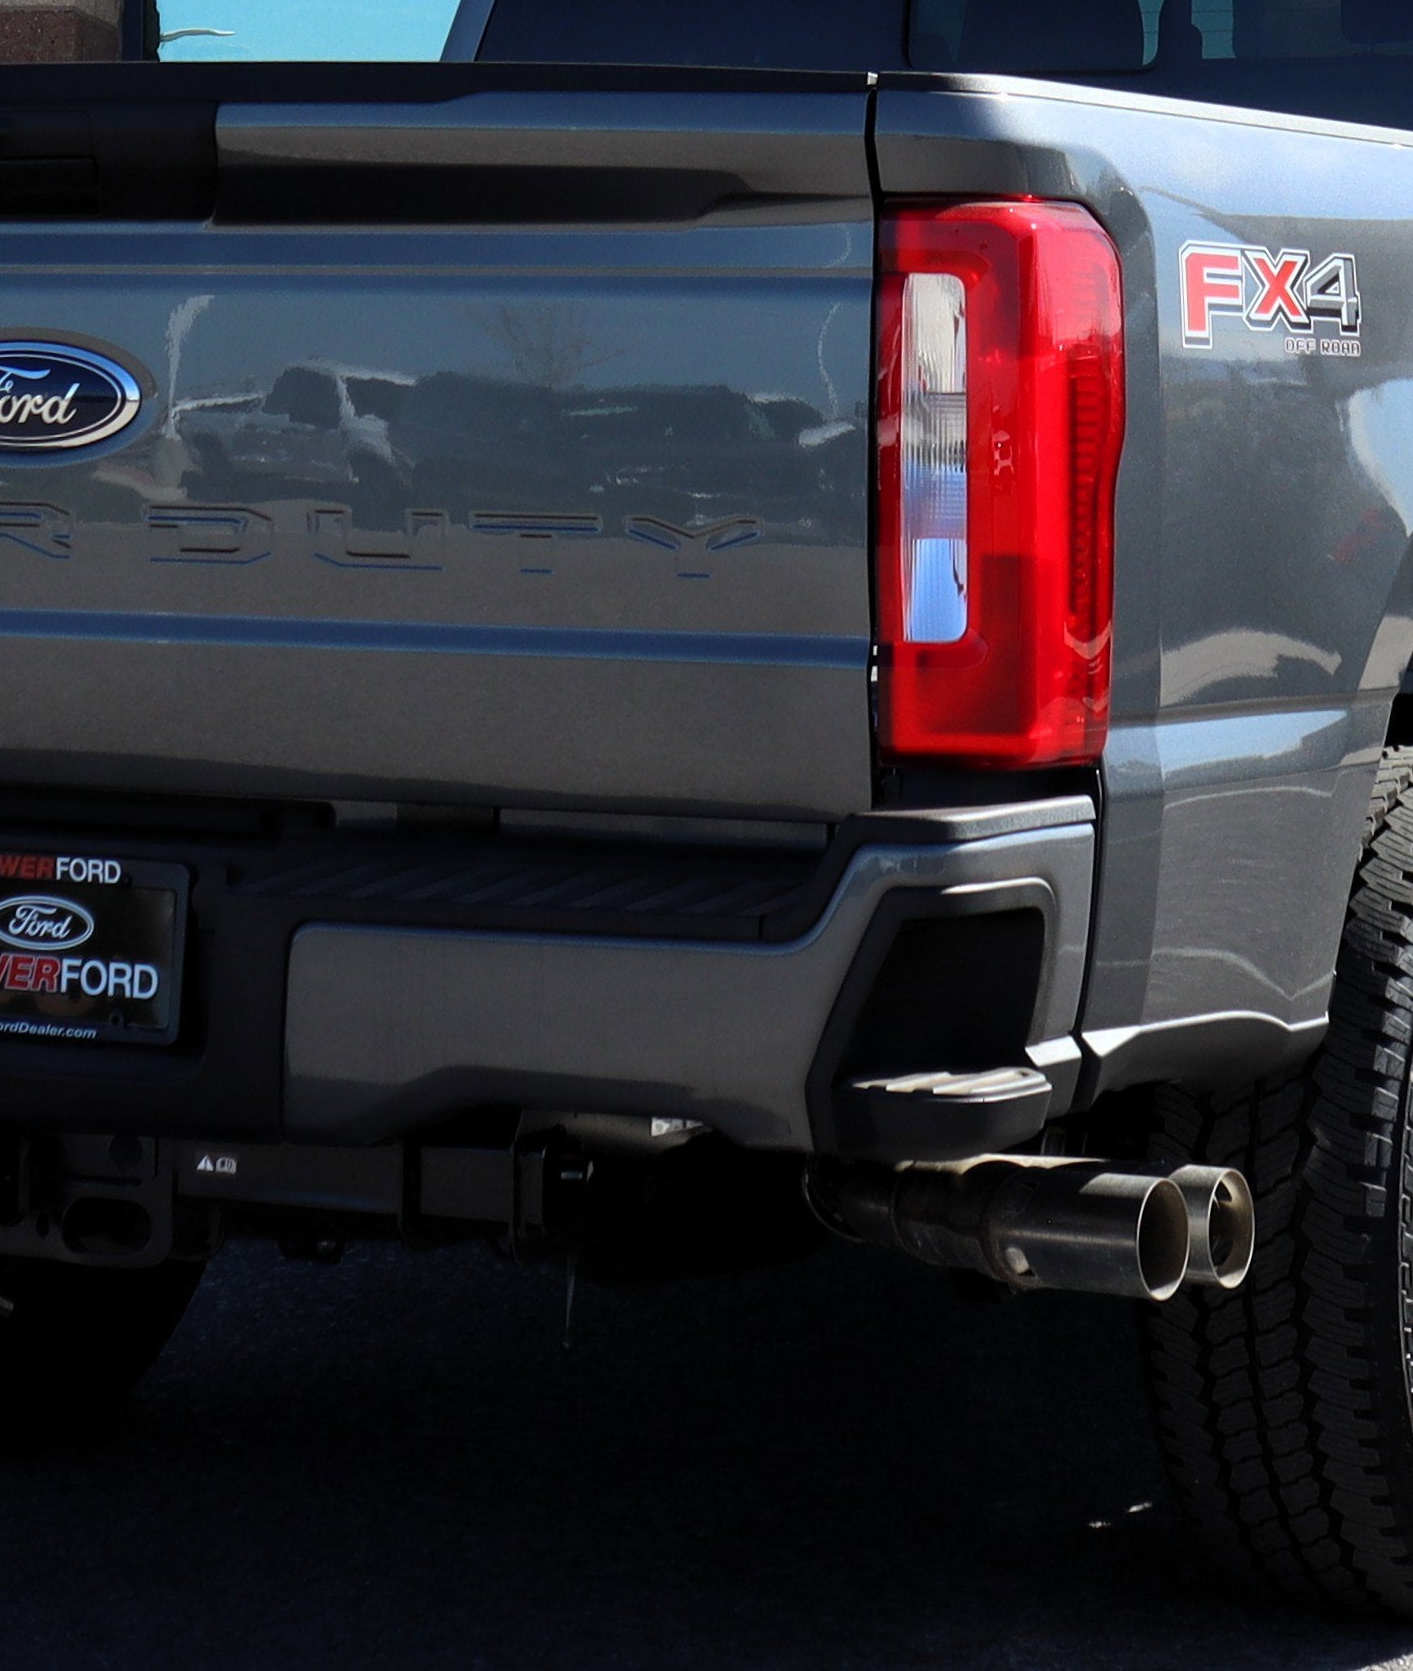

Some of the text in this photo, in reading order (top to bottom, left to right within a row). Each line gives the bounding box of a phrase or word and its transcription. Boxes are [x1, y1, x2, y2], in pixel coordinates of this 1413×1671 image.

[1179, 240, 1361, 349] FX4
[1285, 337, 1361, 357] OFF ROAD
[145, 503, 763, 579] DUTY
[8, 905, 71, 939] Ford
